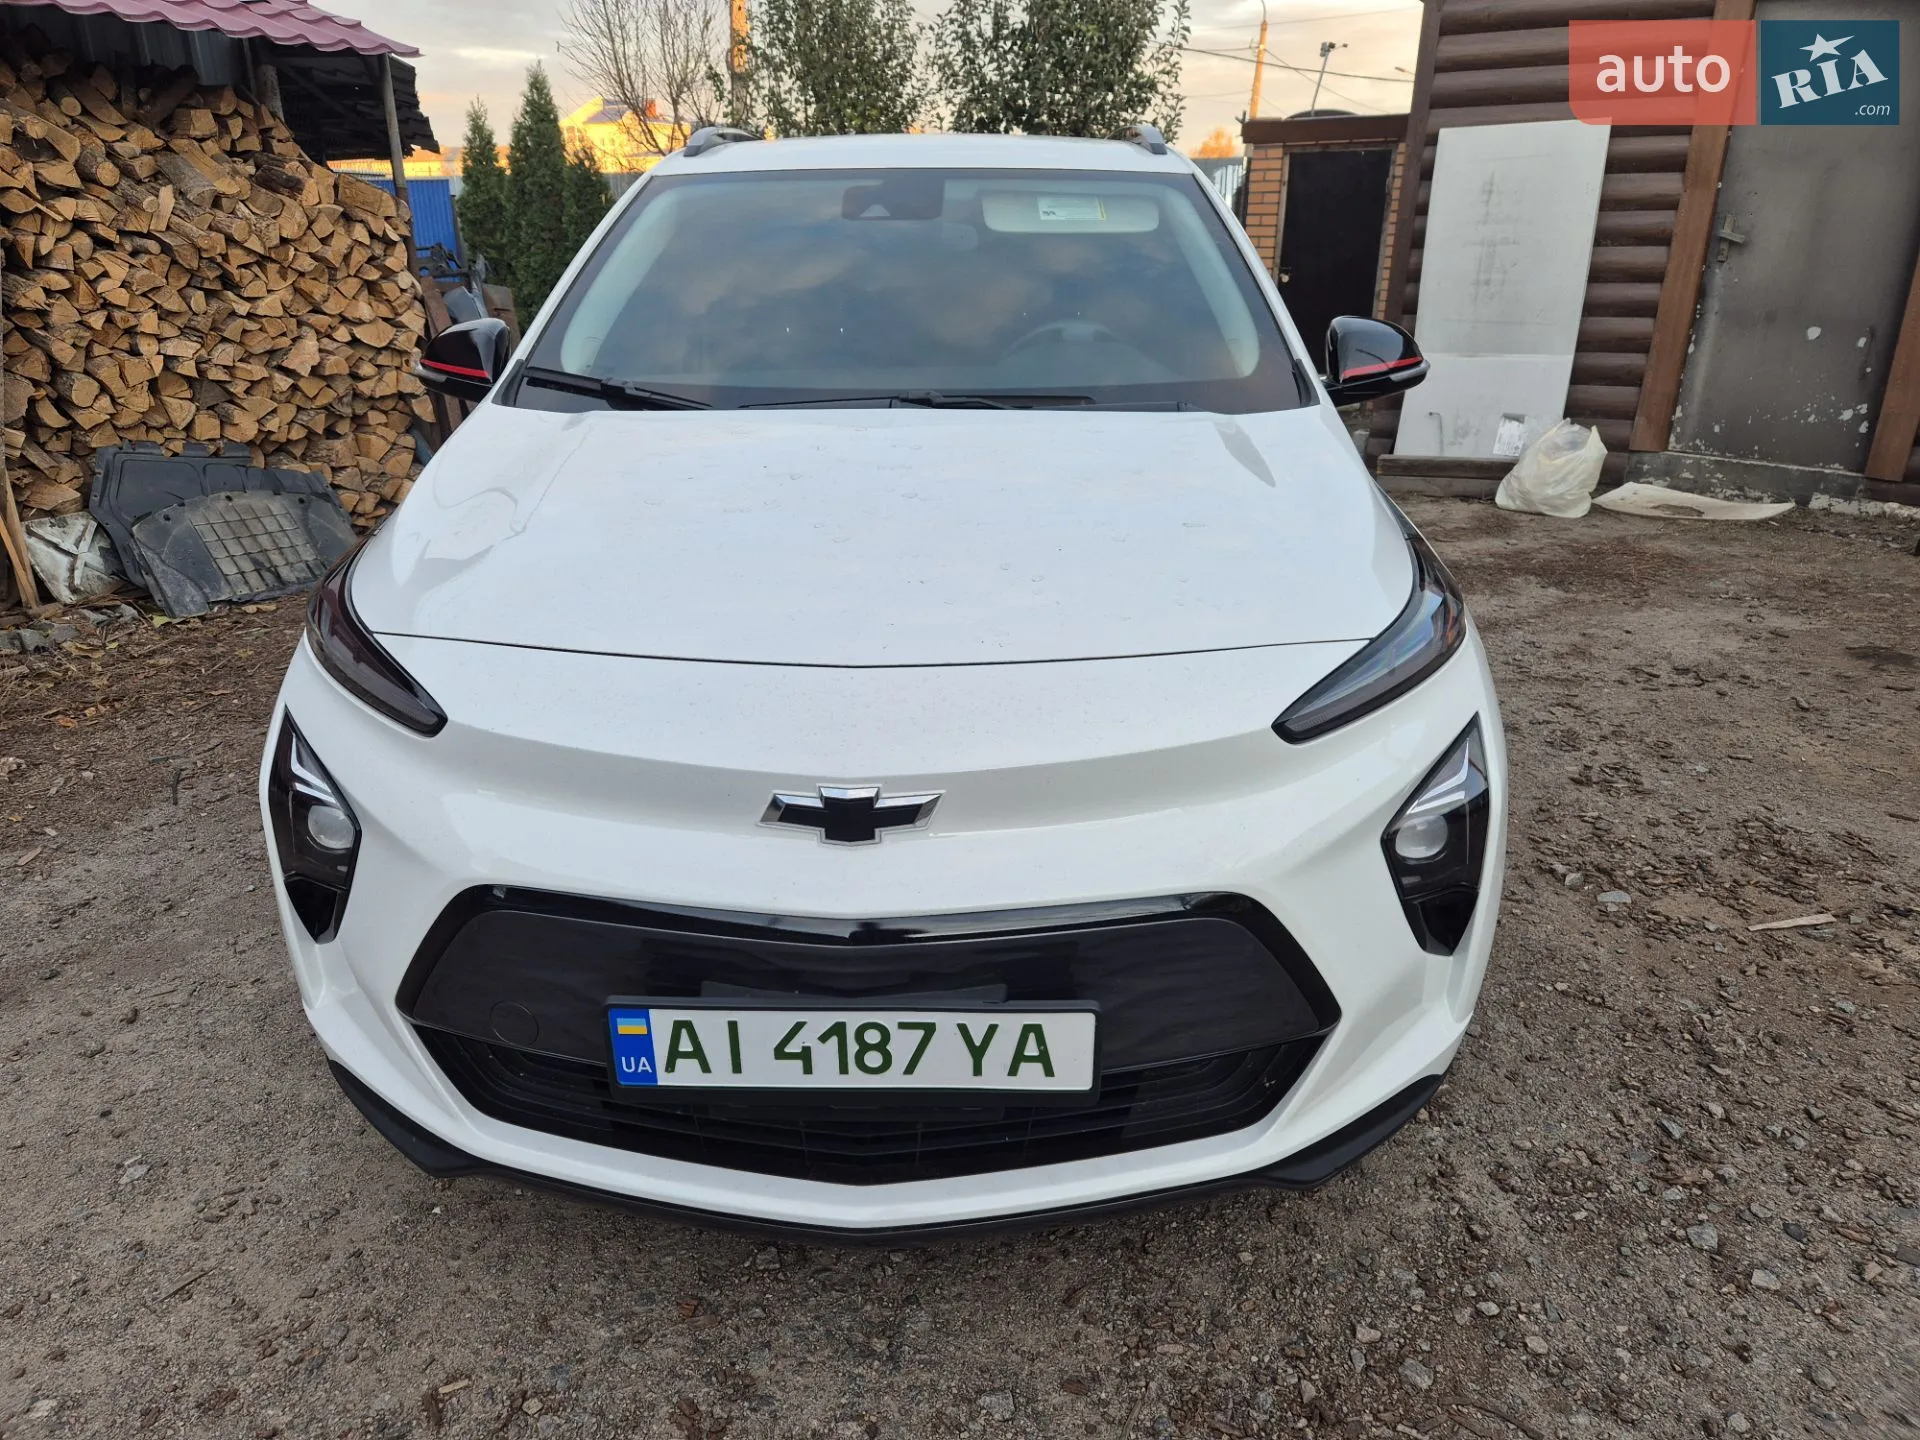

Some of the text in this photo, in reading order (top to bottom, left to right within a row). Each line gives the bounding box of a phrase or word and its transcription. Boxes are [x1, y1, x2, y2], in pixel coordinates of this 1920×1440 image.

[621, 1056, 653, 1073] UA
[664, 1019, 1055, 1078] AI 4187 YA
